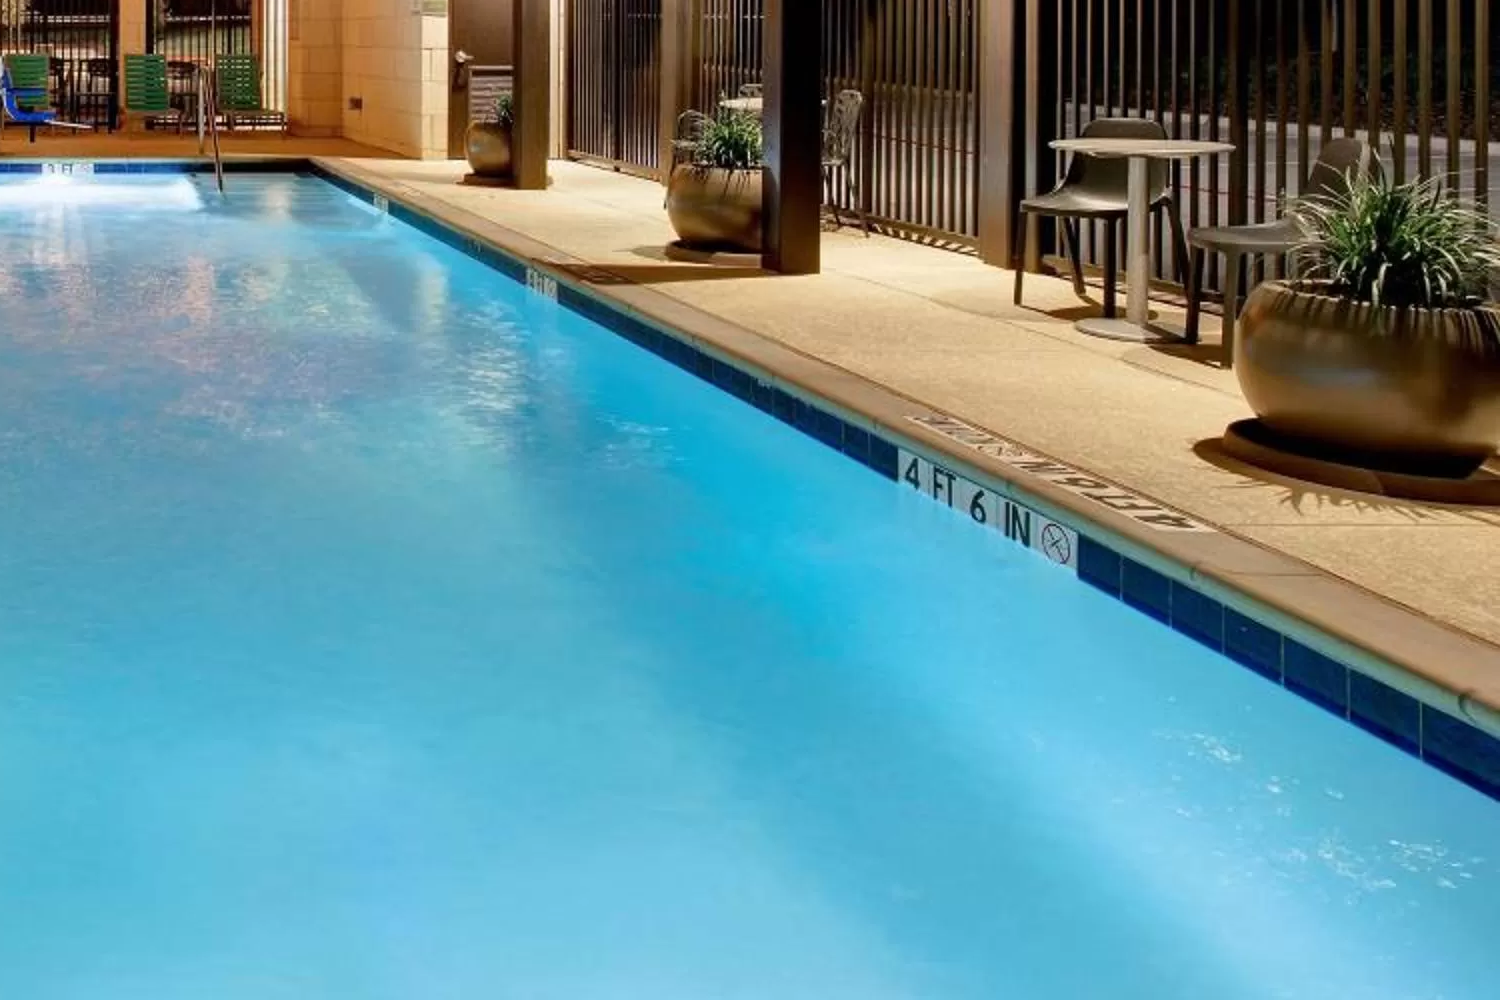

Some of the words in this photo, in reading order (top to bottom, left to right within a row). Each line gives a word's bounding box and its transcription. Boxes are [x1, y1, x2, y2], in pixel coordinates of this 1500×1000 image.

[1052, 477, 1109, 489] 6
[905, 458, 920, 490] 4
[933, 465, 956, 508] FT
[970, 490, 986, 523] 6
[1004, 502, 1030, 548] IN
[1081, 492, 1163, 511] FT
